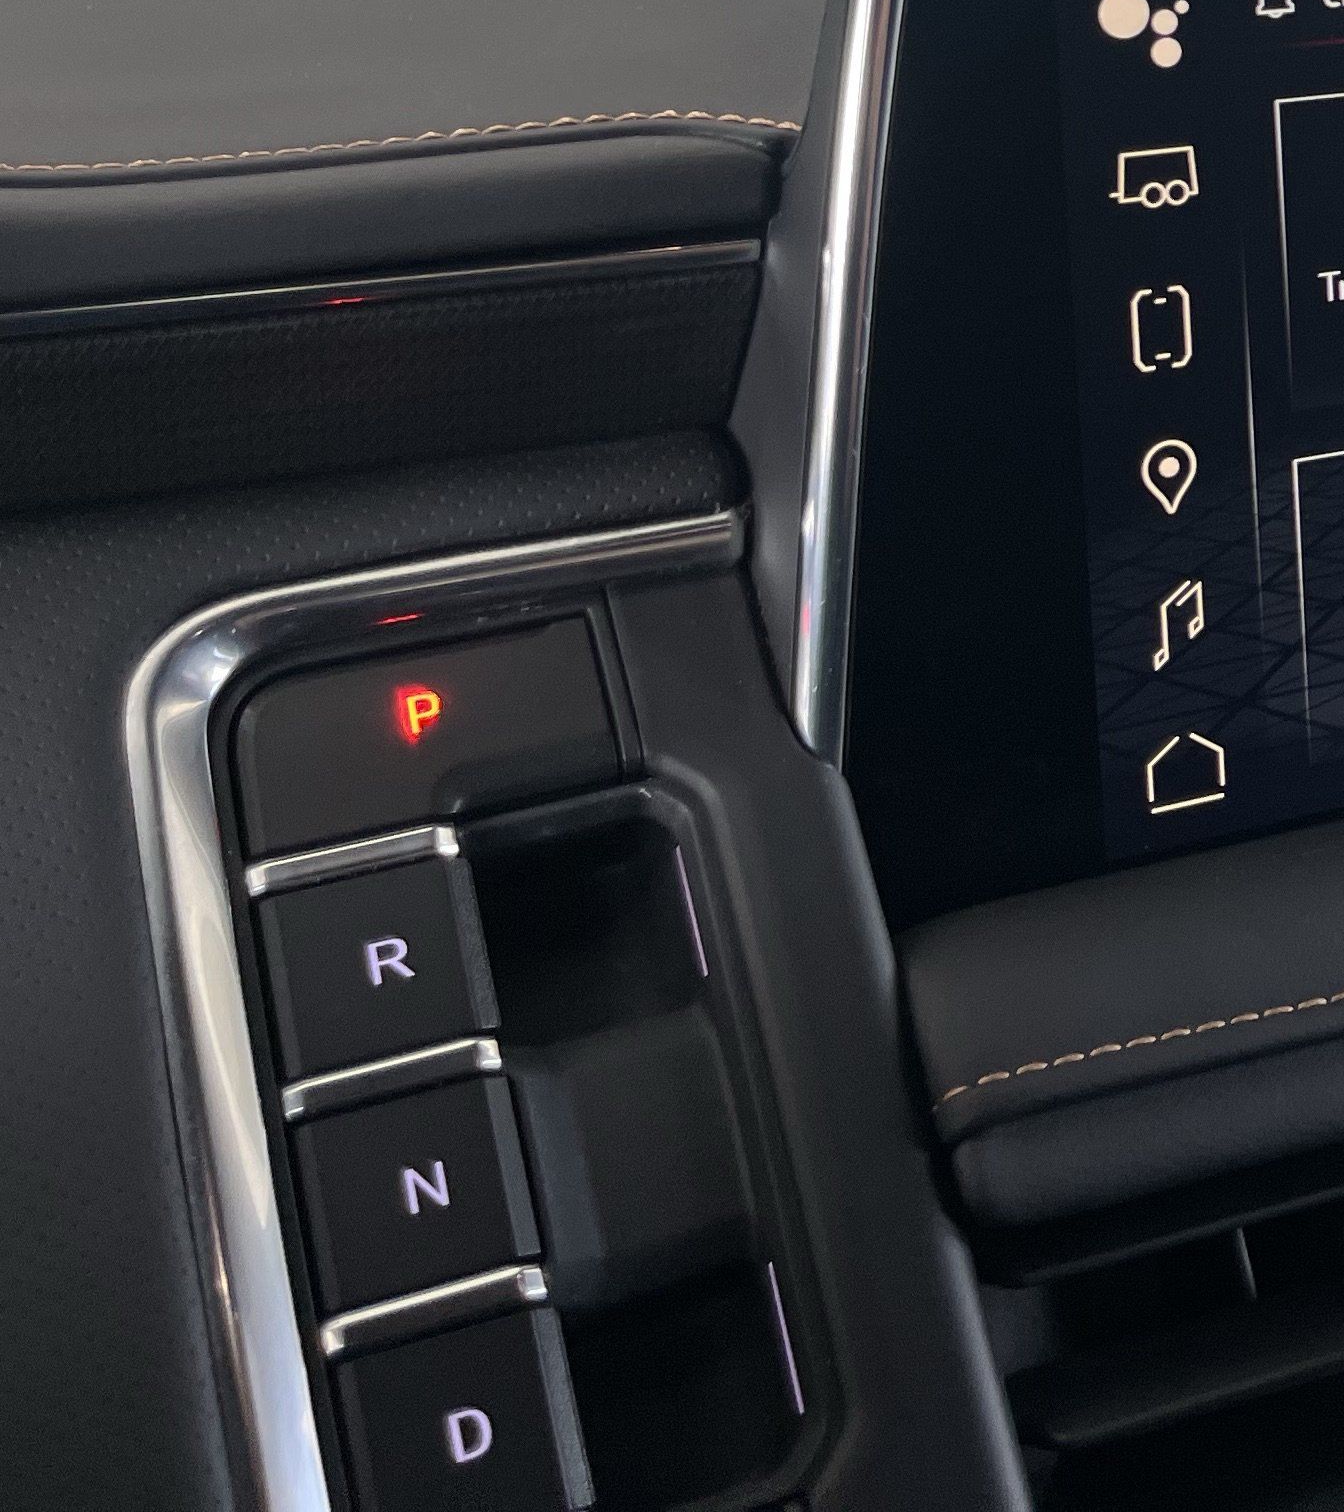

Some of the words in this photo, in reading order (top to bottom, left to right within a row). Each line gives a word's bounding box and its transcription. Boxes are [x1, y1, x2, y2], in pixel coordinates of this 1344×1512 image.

[398, 687, 443, 740] P
[365, 938, 416, 986] R
[402, 1160, 450, 1215] N
[447, 1408, 494, 1464] D
